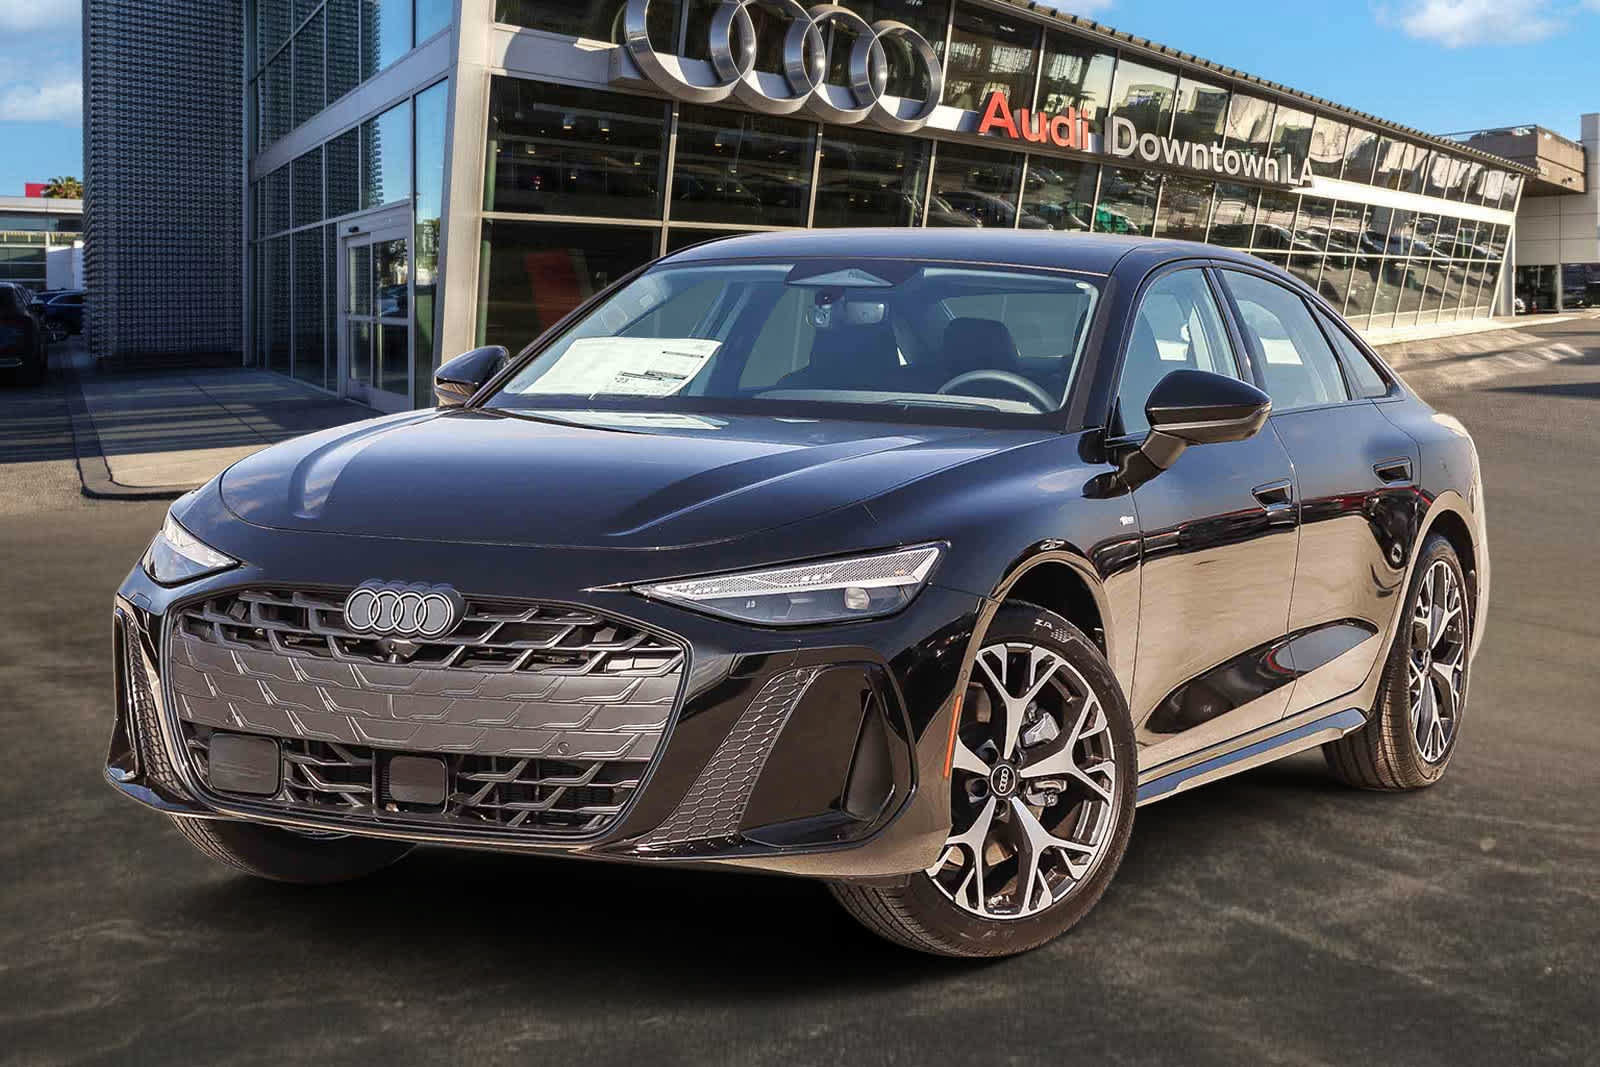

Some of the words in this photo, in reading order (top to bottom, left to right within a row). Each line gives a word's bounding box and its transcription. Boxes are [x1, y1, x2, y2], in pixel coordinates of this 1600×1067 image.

[978, 91, 1089, 151] Audi
[1108, 116, 1279, 183] Downtown
[1286, 153, 1314, 186] LA
